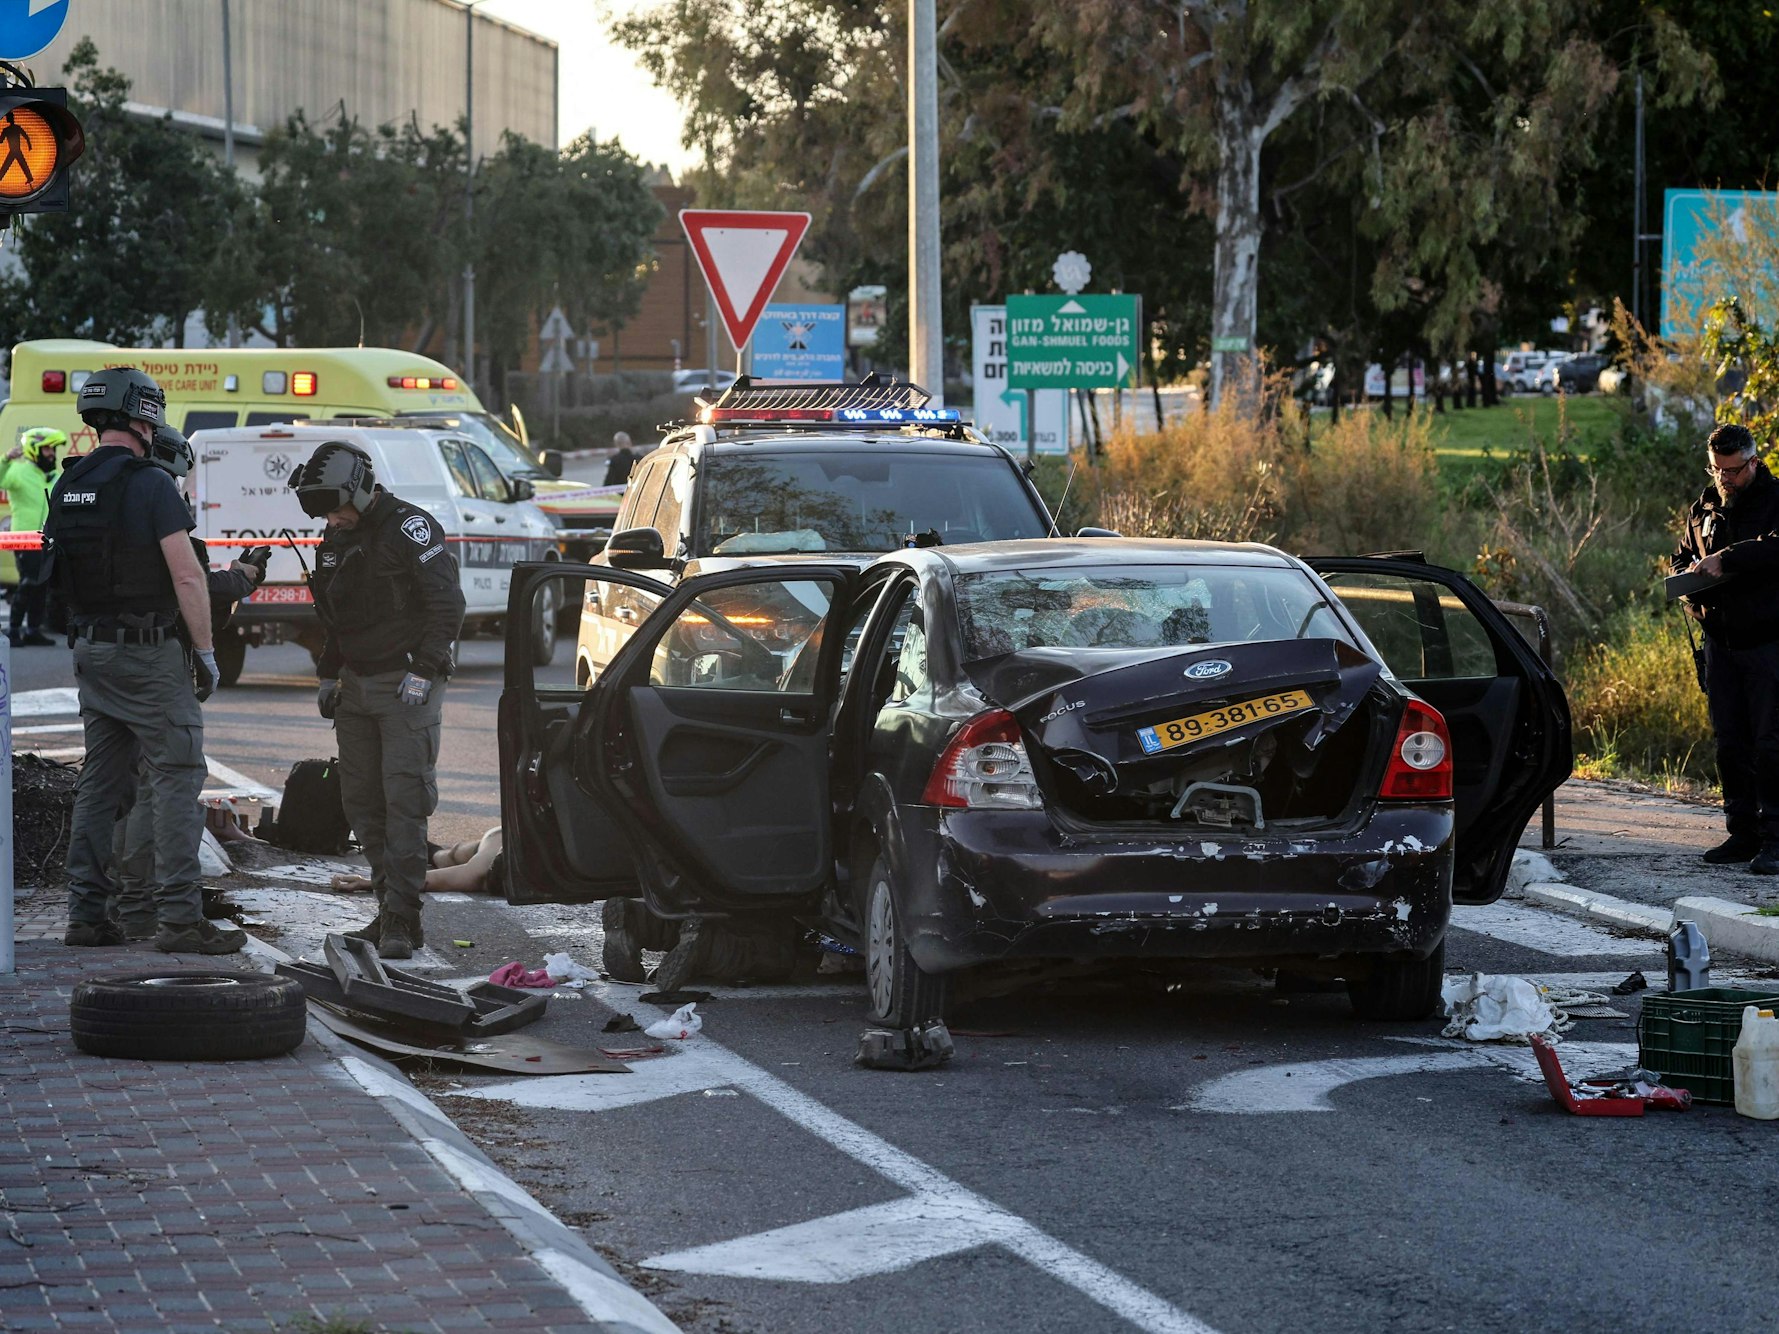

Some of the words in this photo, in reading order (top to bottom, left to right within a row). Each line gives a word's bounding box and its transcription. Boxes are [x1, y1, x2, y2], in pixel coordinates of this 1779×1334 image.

[1011, 318, 1044, 335] מזון
[1051, 314, 1130, 335] גן-שמואל
[1091, 335, 1130, 347] FOODS
[142, 361, 179, 375] טיפול
[184, 363, 219, 375] ניידת
[1012, 357, 1072, 376] למשאיות
[1075, 361, 1114, 375] כניסה
[176, 380, 197, 391] CARE
[199, 380, 218, 391] UNIT
[63, 491, 81, 503] חבלה
[81, 492, 96, 504] קצין
[241, 486, 277, 496] ישראל
[221, 529, 326, 548] TOYOT
[1194, 661, 1223, 677] Ford
[1039, 700, 1087, 724] FOCUS
